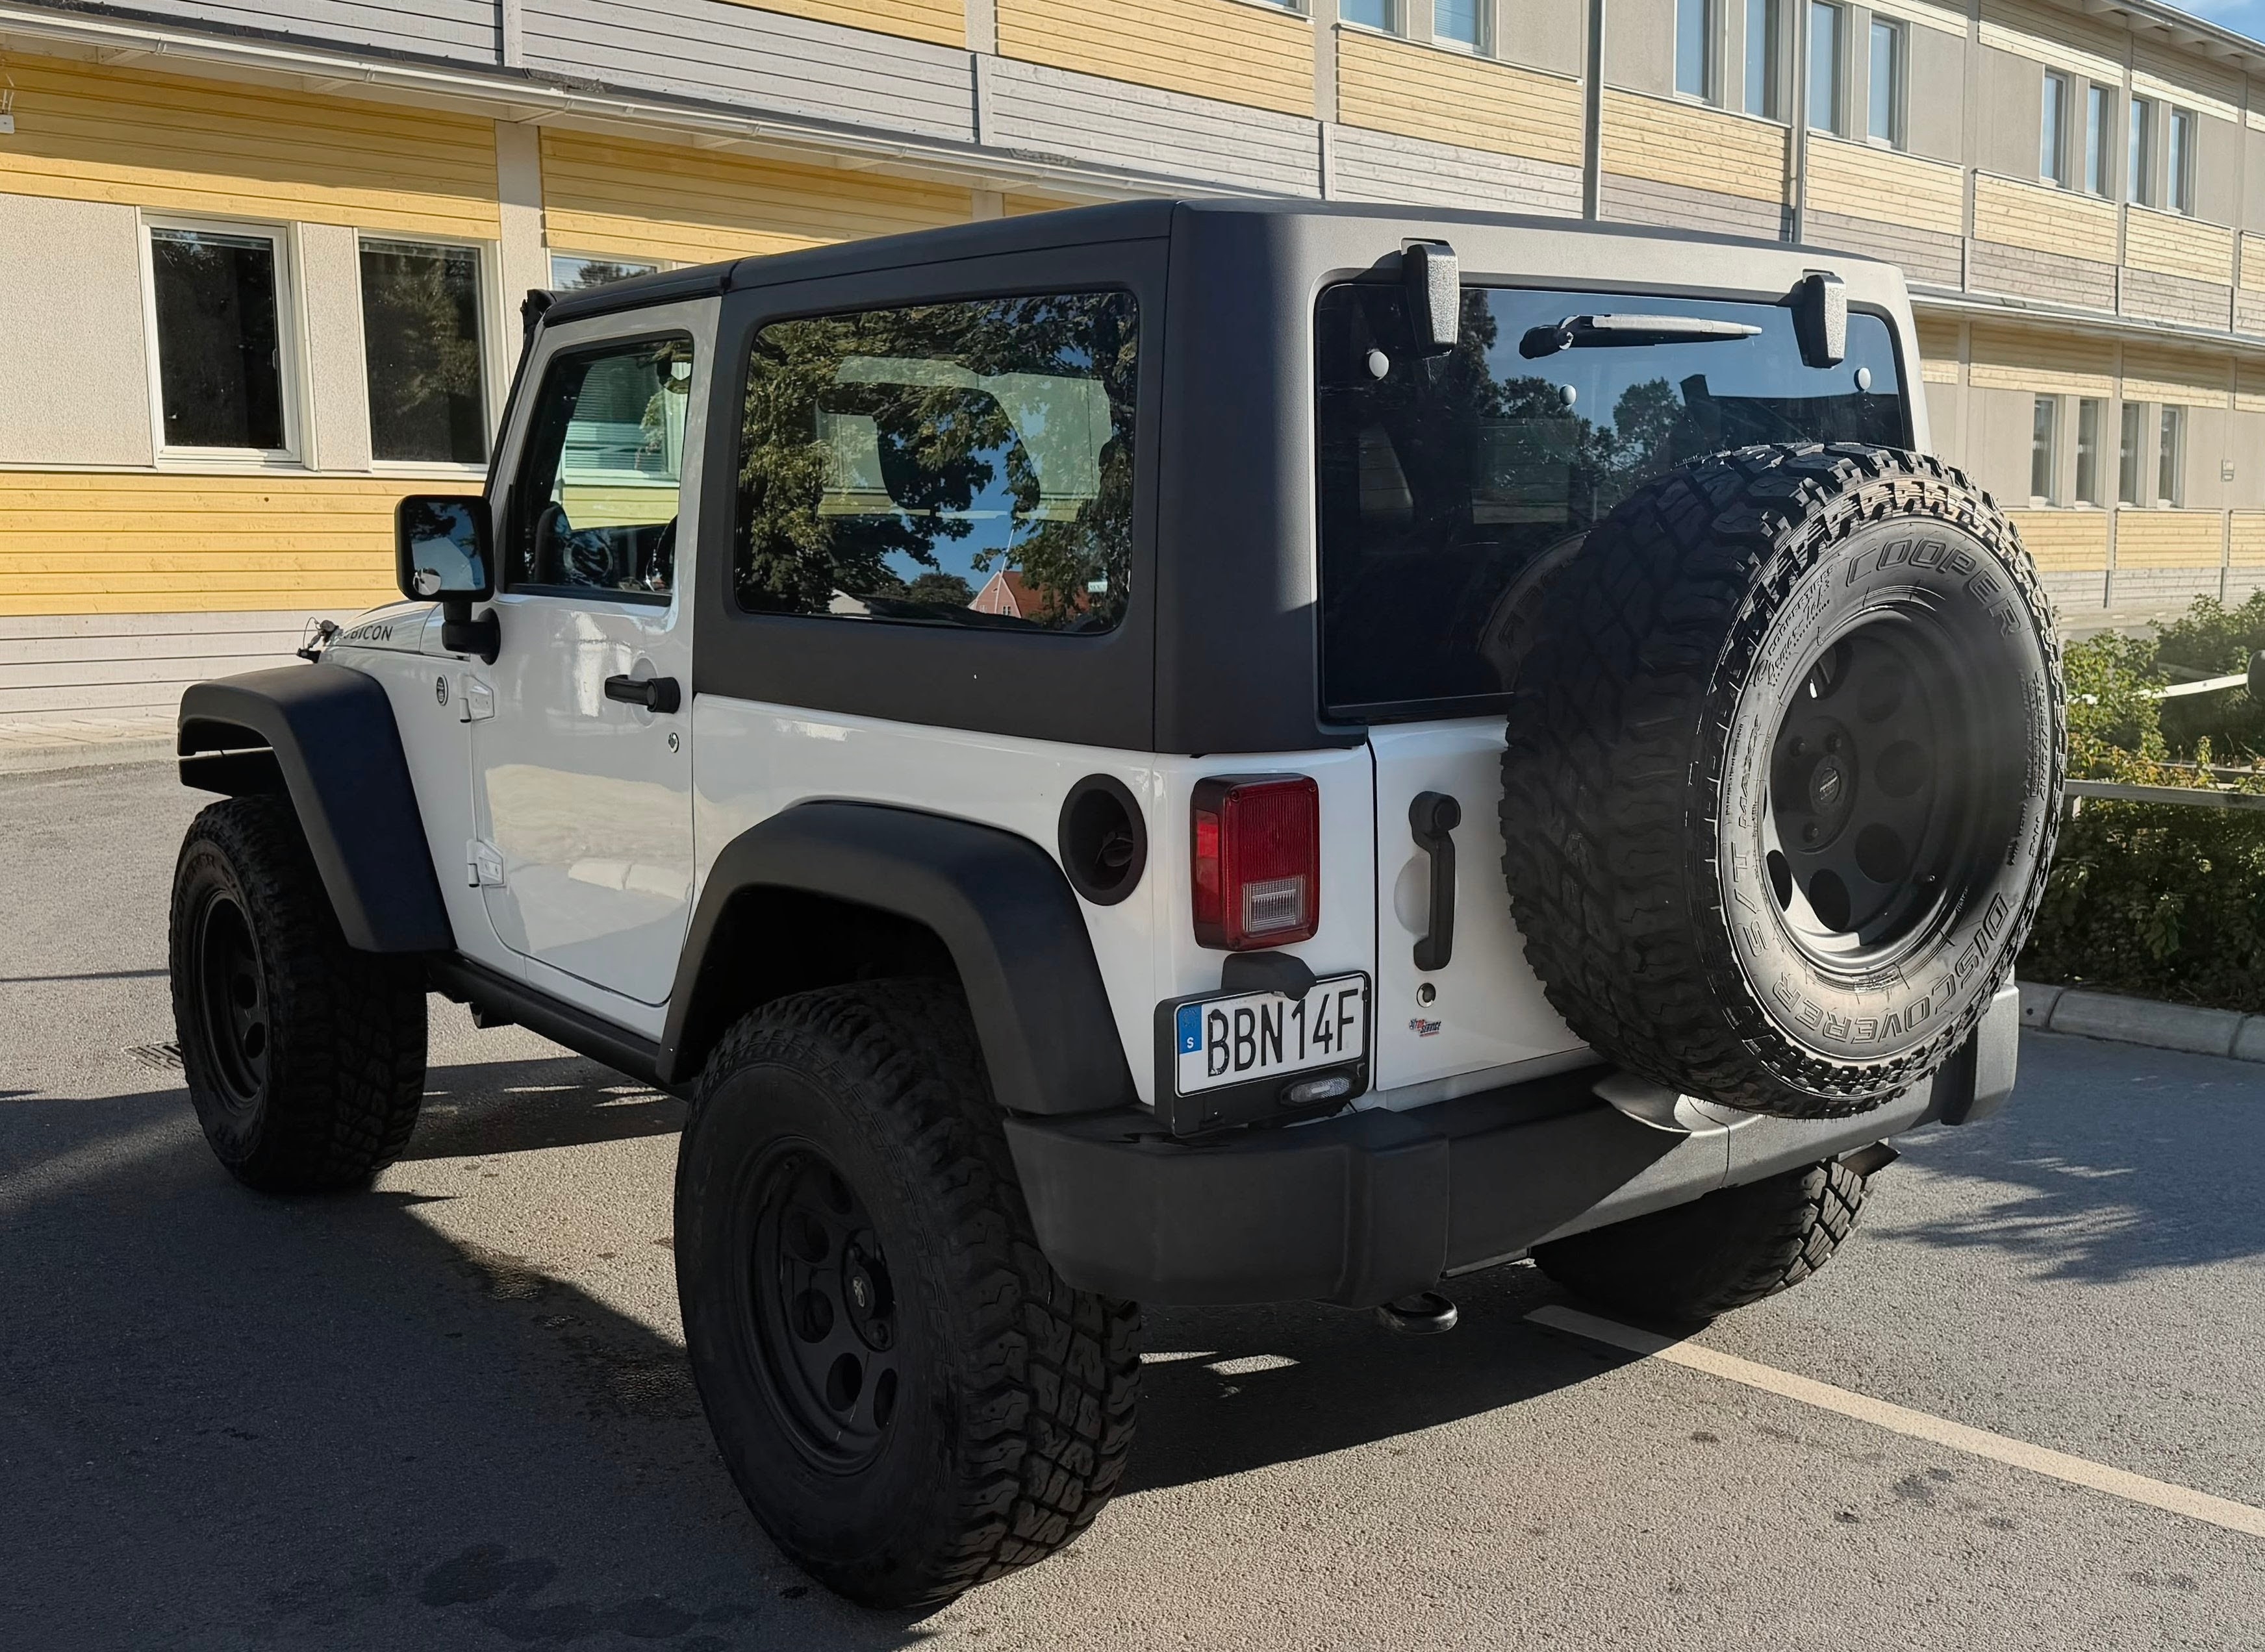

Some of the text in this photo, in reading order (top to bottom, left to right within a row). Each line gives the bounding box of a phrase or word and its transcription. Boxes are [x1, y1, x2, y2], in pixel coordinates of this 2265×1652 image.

[1846, 538, 2021, 638] COOPER
[344, 625, 393, 641] BICON
[1772, 892, 2009, 1044] DISCOVERER
[1187, 1037, 1194, 1049] S
